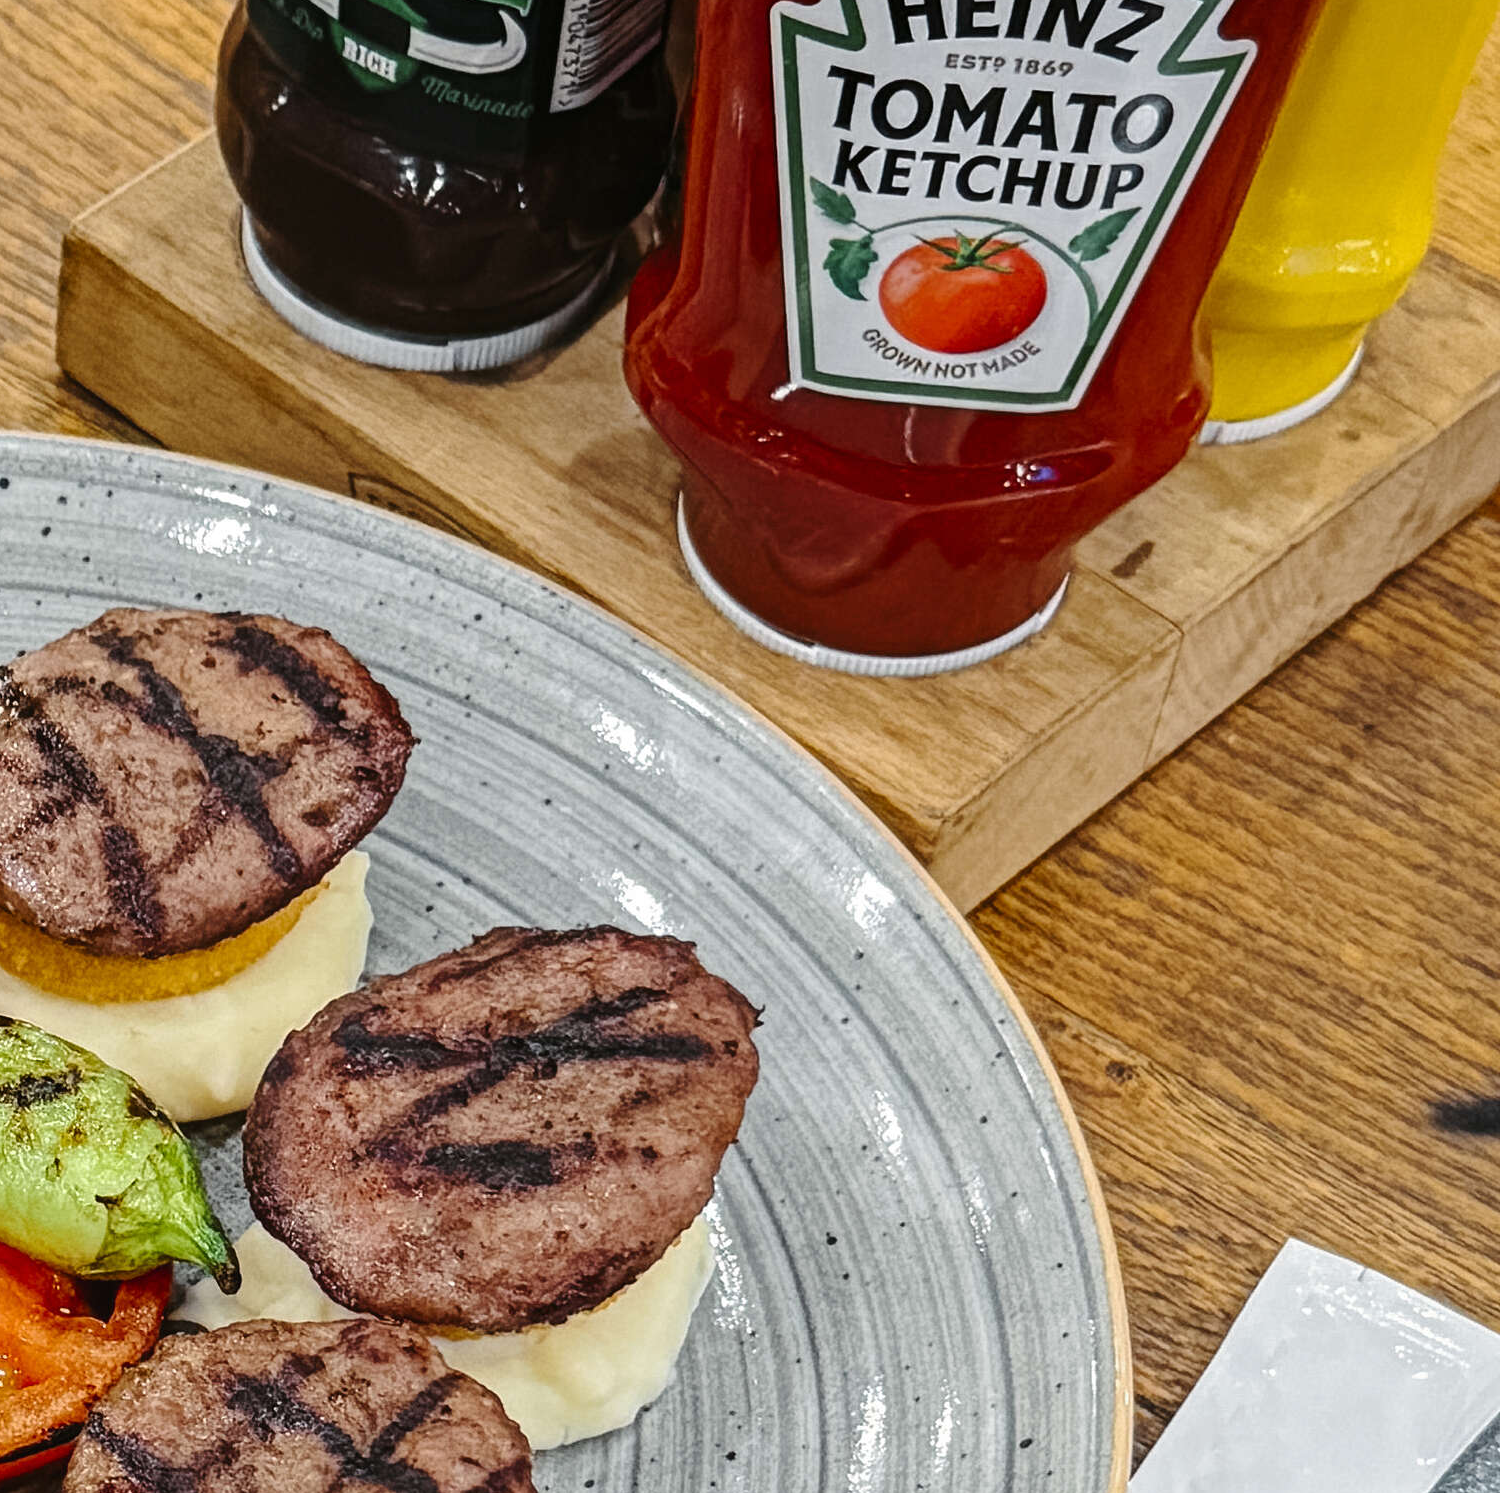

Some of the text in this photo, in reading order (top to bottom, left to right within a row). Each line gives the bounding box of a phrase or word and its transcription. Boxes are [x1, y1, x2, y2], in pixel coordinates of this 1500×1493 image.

[342, 36, 399, 84] RICH
[1013, 57, 1075, 78] 1869
[825, 64, 1175, 156] TOMATO
[831, 138, 1145, 210] KETCHUP
[862, 328, 1041, 381] GROWN NOT MADE
